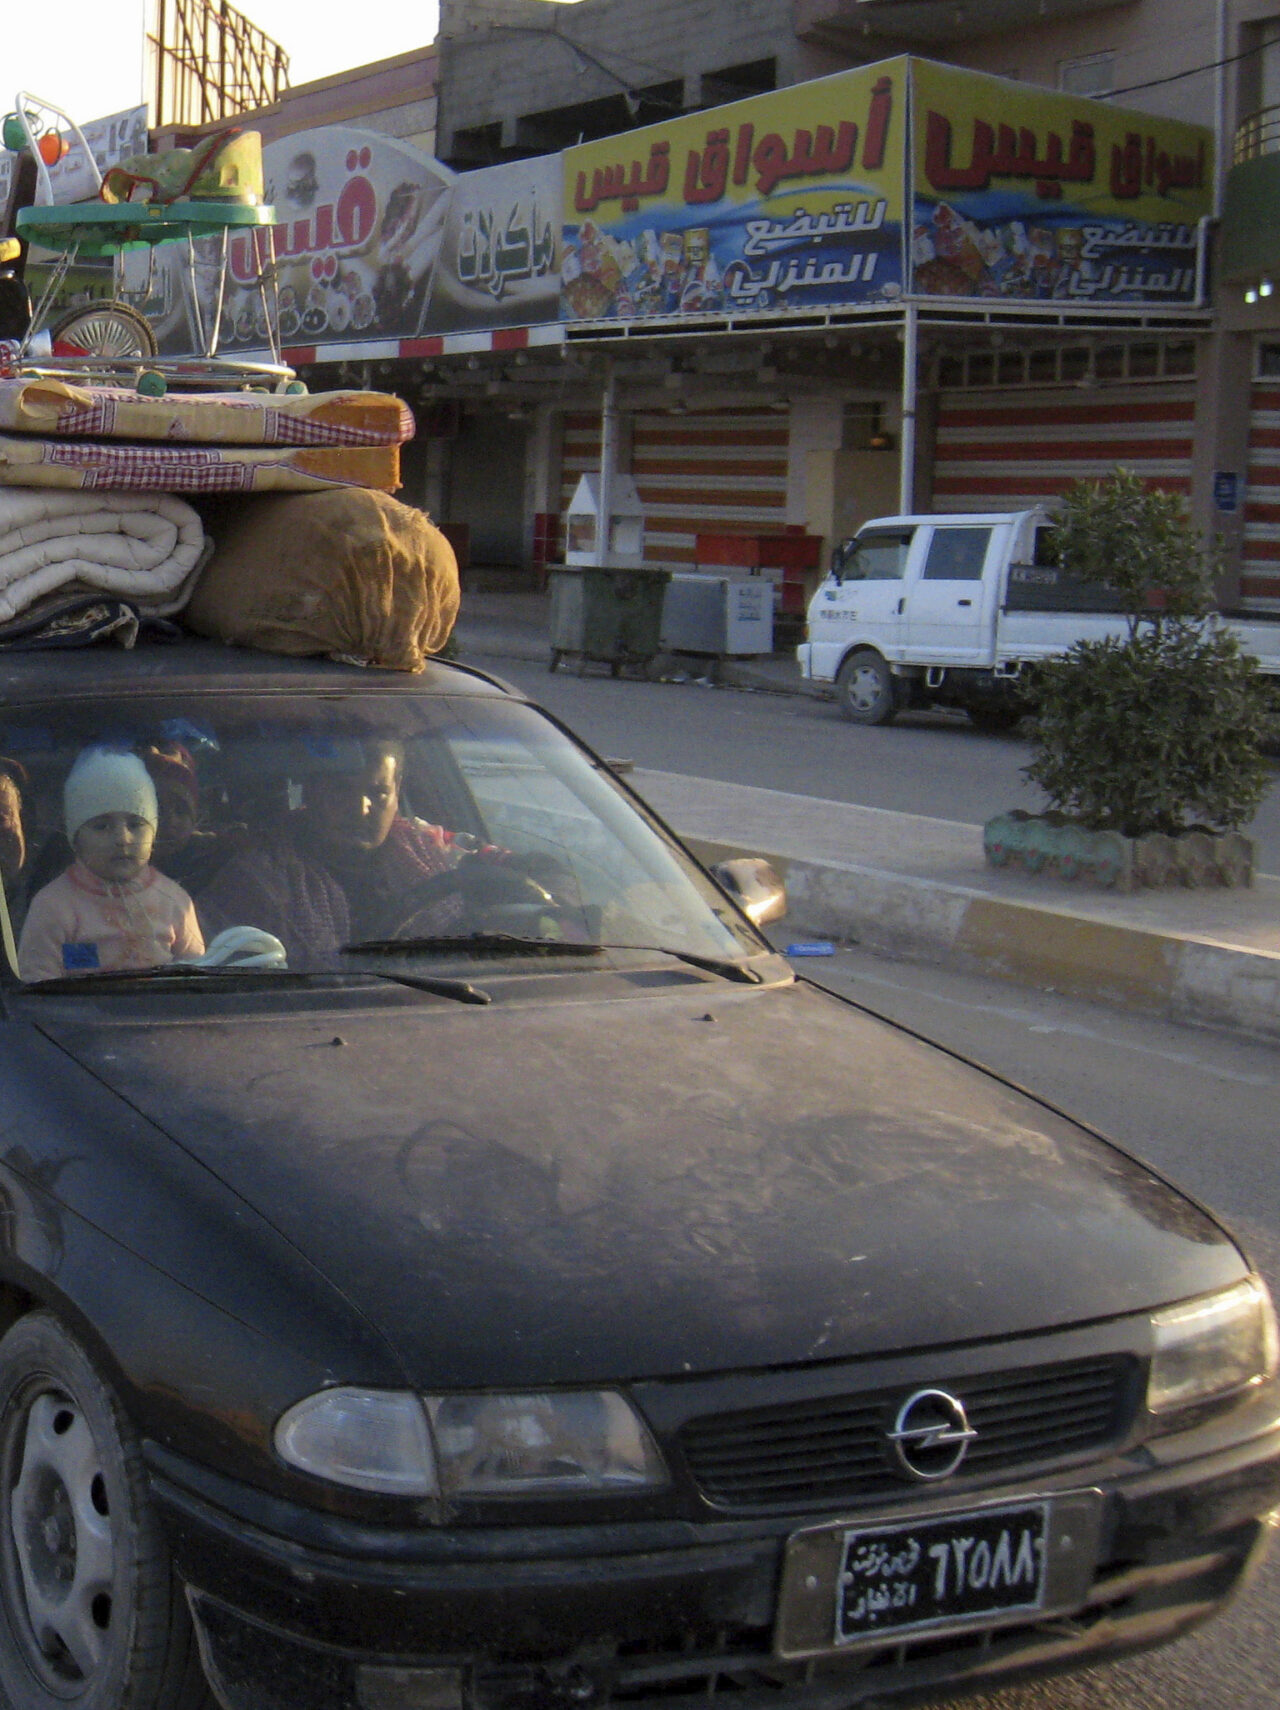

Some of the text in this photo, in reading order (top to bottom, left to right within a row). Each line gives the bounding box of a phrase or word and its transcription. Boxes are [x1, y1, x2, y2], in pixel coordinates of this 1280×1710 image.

[574, 75, 893, 213] أسواق قيس
[924, 109, 1095, 200] قيس
[744, 199, 888, 257] للتبضع
